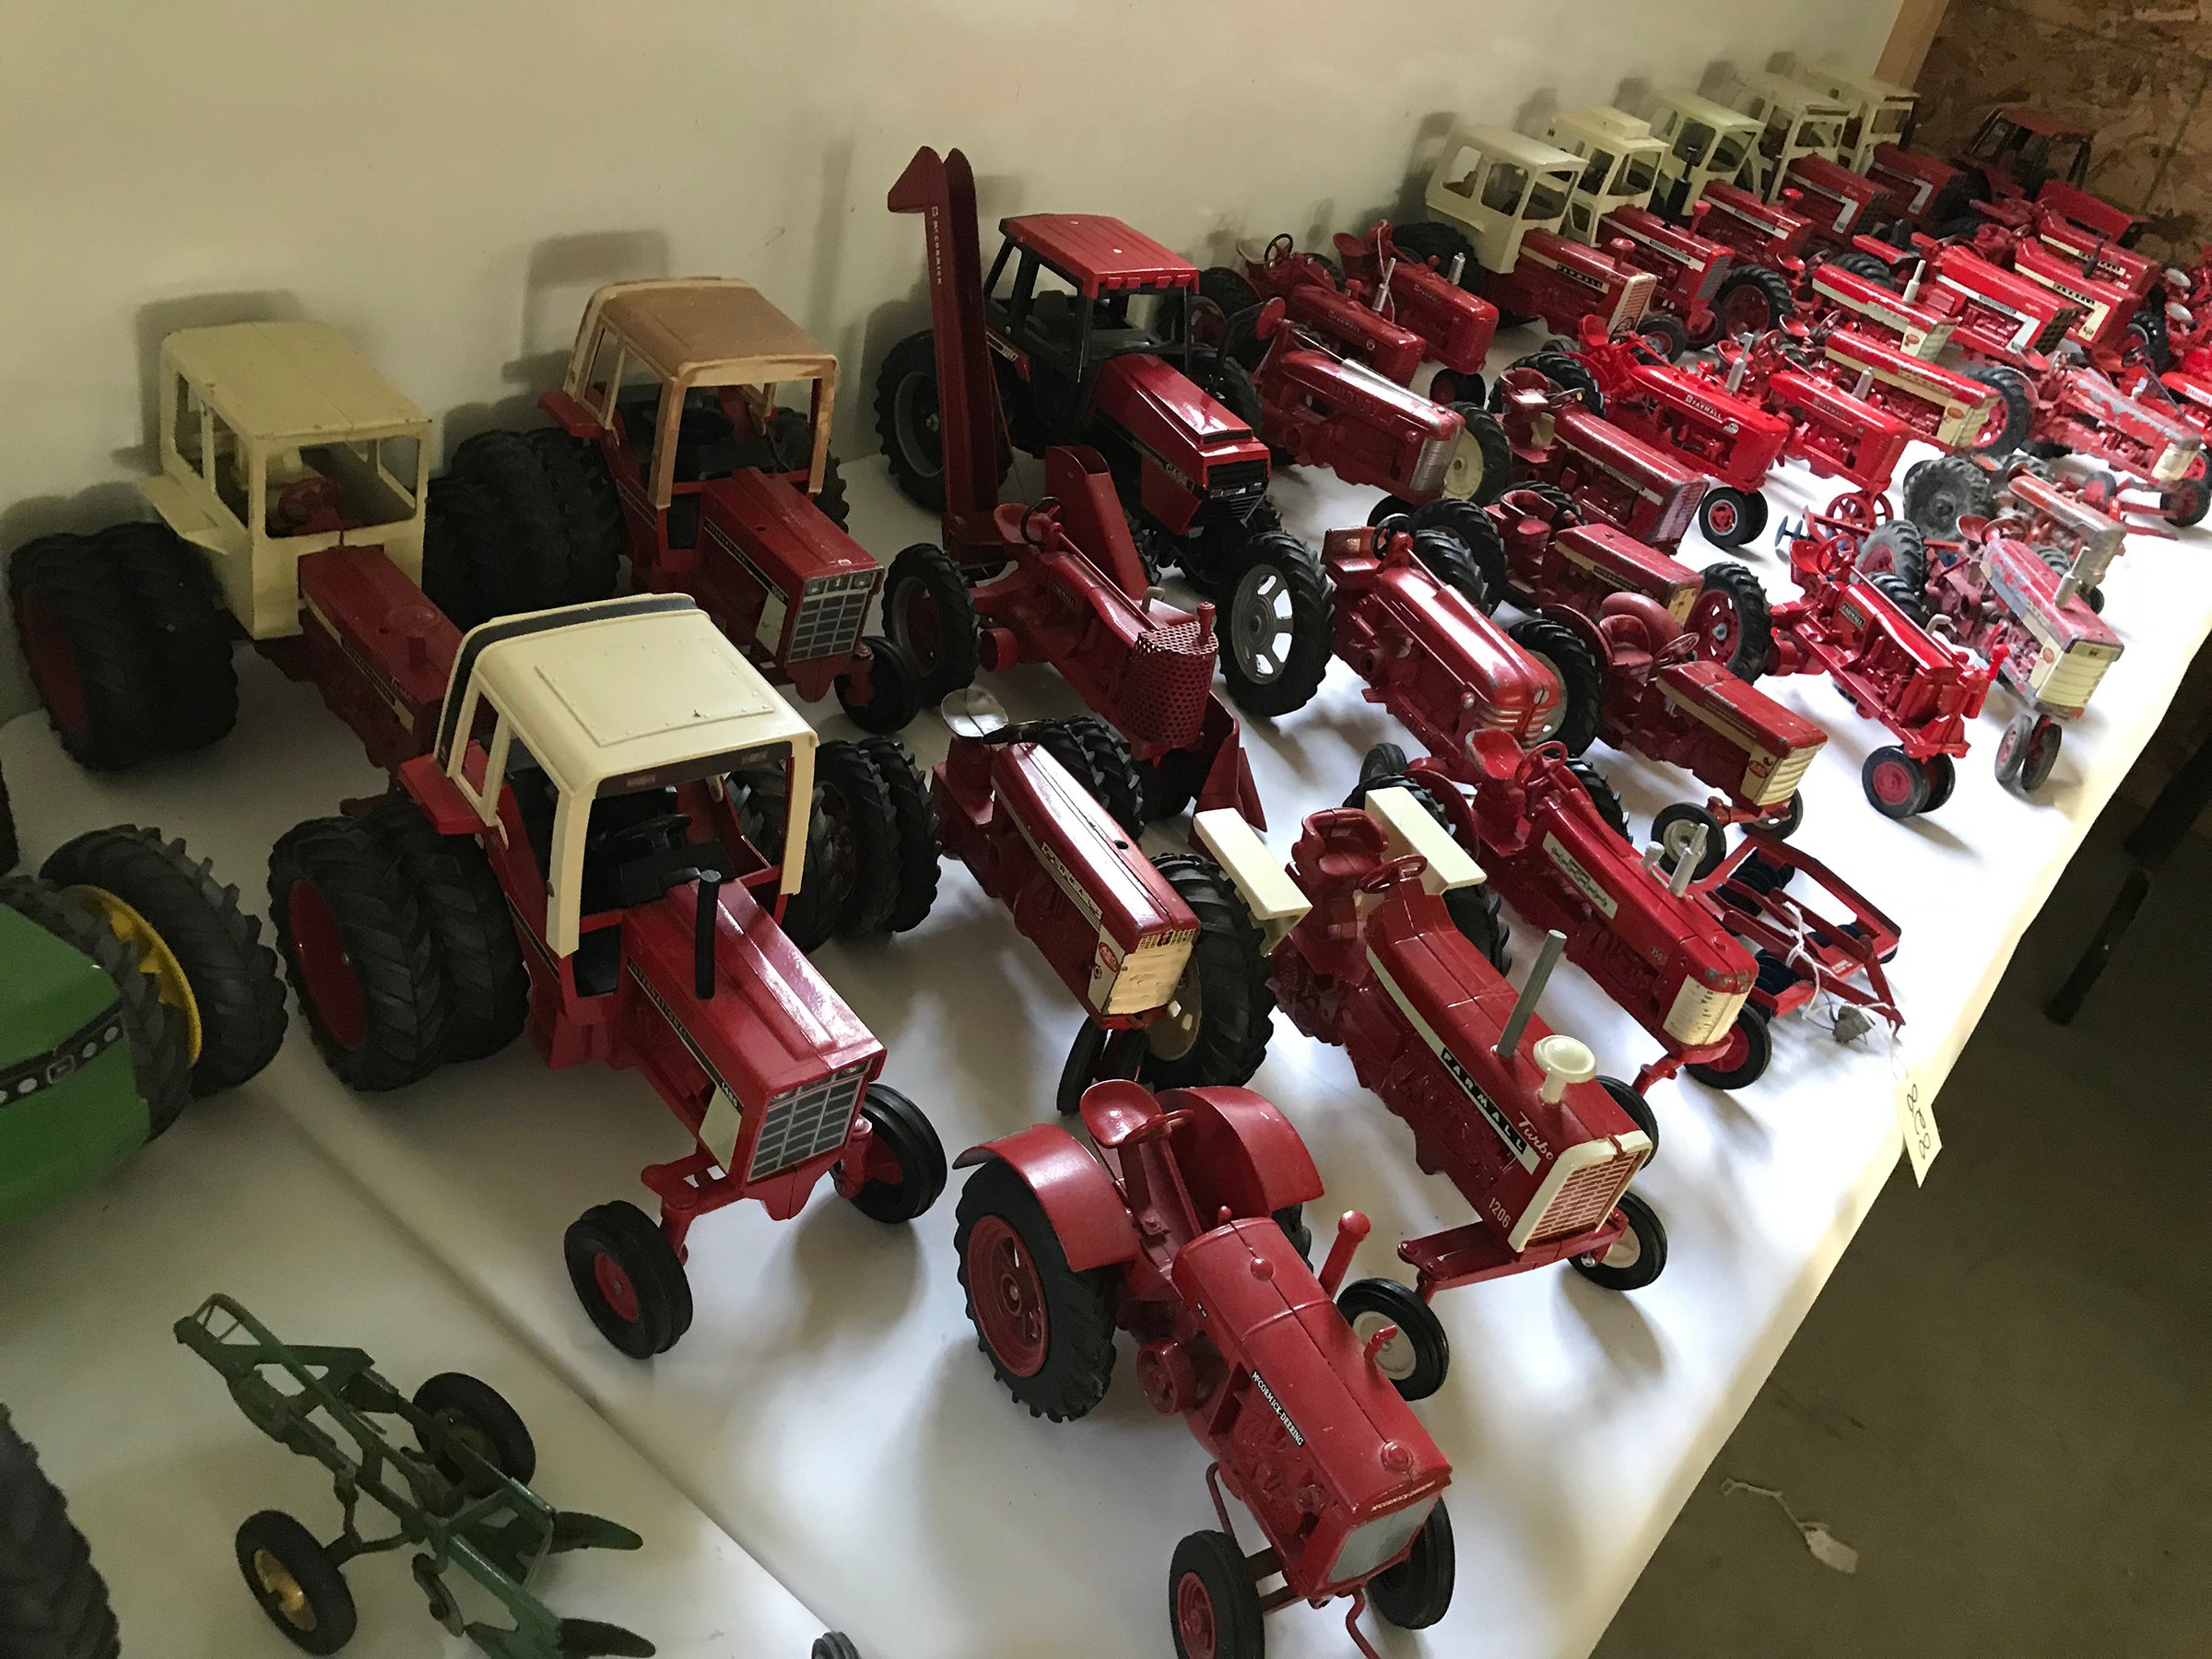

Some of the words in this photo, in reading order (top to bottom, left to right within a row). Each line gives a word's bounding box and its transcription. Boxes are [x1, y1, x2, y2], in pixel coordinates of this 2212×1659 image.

[1442, 1051, 1524, 1152] FARMALL
[1906, 1083, 1931, 1160] 828
[1517, 1110, 1555, 1161] Turbo
[1488, 1196, 1512, 1230] 1206
